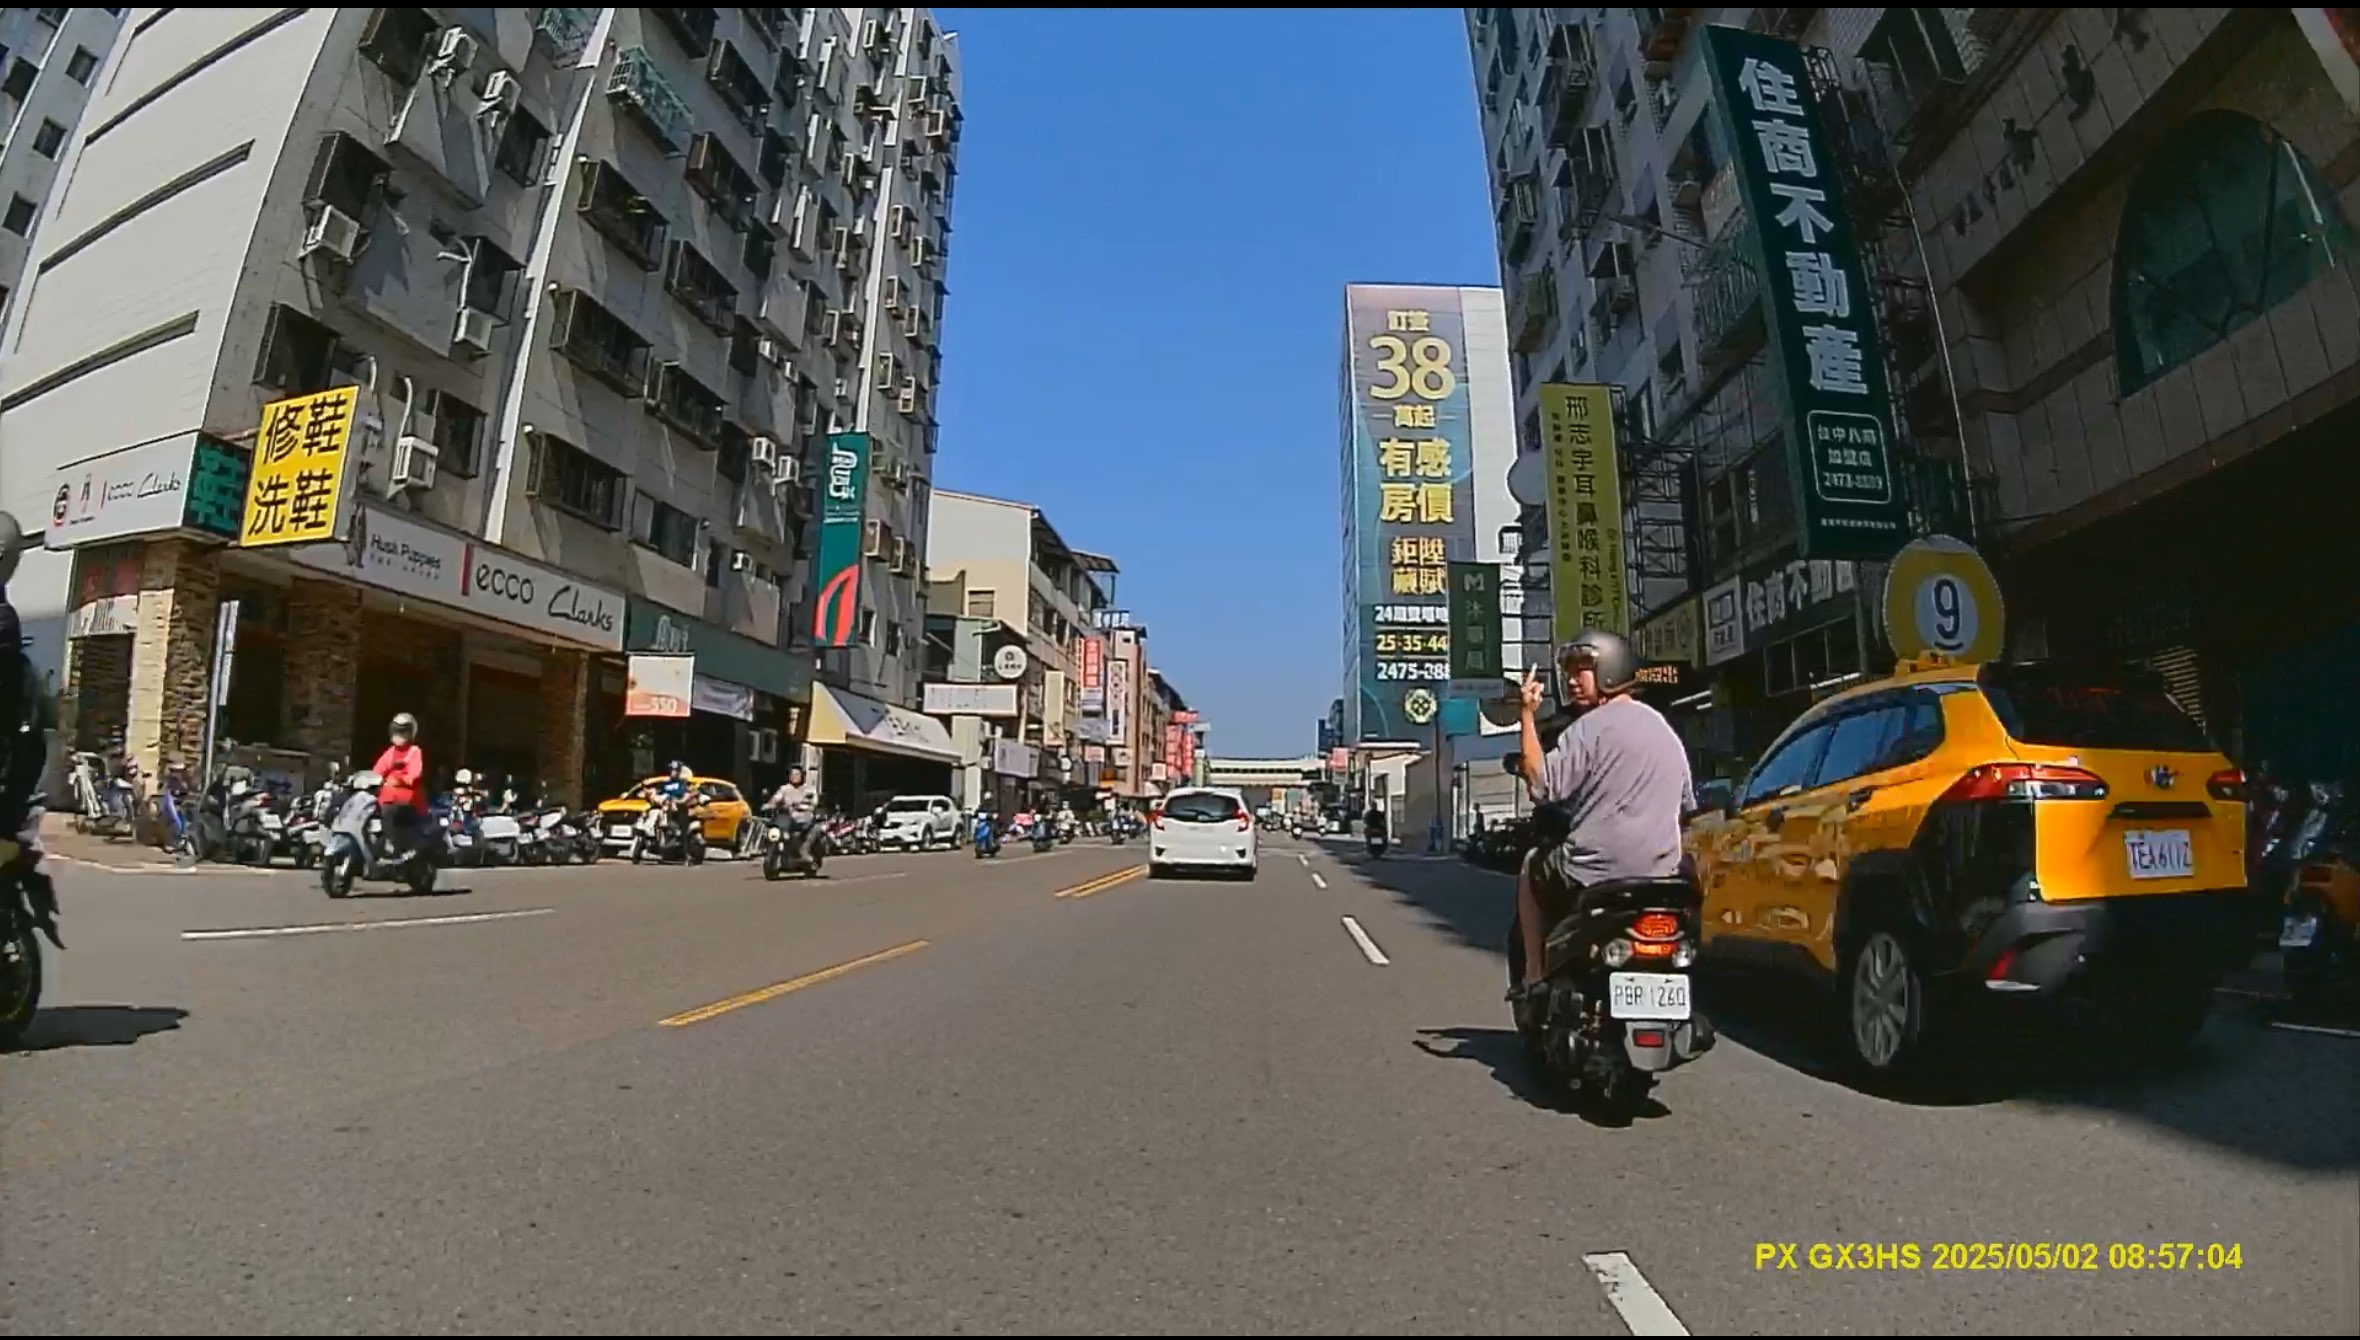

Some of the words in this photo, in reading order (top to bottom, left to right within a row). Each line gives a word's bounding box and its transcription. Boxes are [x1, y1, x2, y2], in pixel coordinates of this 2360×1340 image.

[1738, 57, 1869, 394] 住商不動產
[1369, 335, 1456, 400] 38
[263, 393, 348, 465] 修鞋
[1378, 436, 1452, 478] 有感
[247, 466, 334, 536] 洗鞋
[1379, 482, 1455, 523] 房價
[476, 562, 534, 605] ecco
[547, 585, 615, 633] Clarks
[1934, 578, 1960, 640] 9
